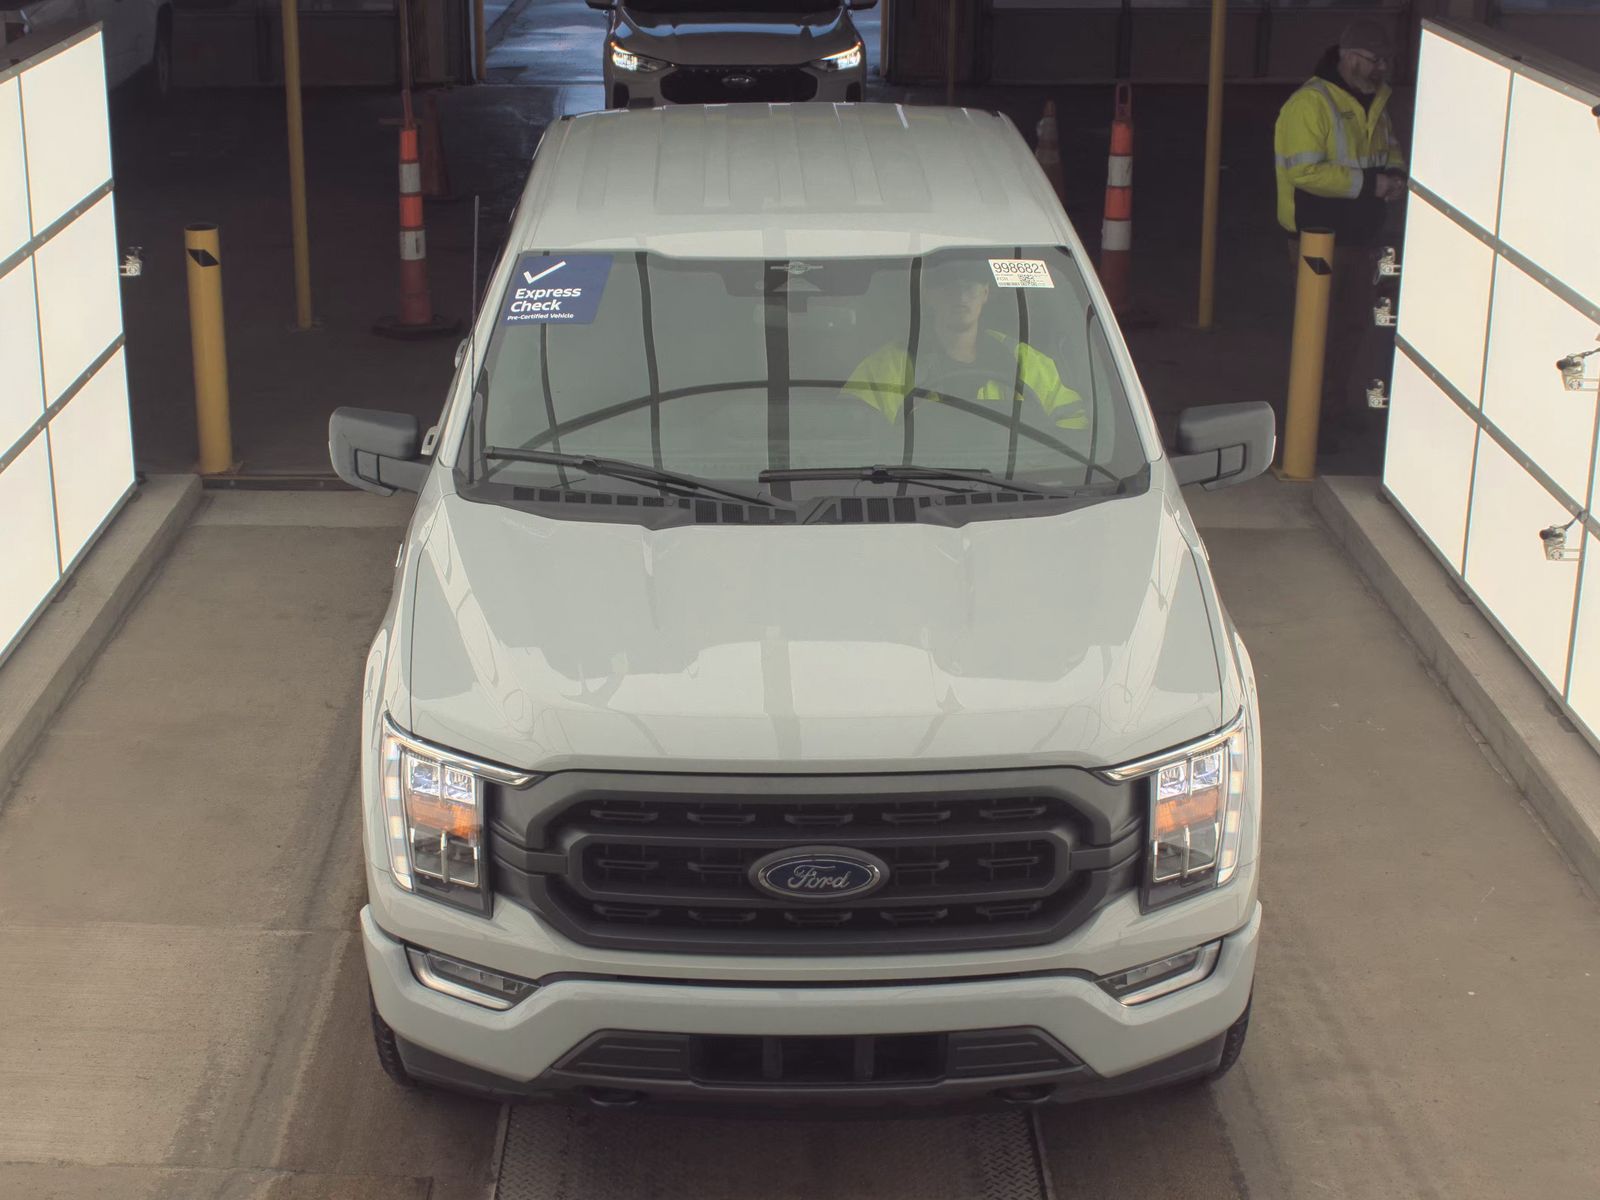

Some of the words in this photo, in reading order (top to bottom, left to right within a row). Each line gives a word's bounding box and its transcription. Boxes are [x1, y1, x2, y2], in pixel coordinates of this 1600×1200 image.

[992, 262, 1047, 274] 9986821
[514, 287, 582, 300] Express
[510, 299, 562, 312] Check
[507, 313, 549, 321] Pre-Certified
[787, 864, 852, 889] Ford
